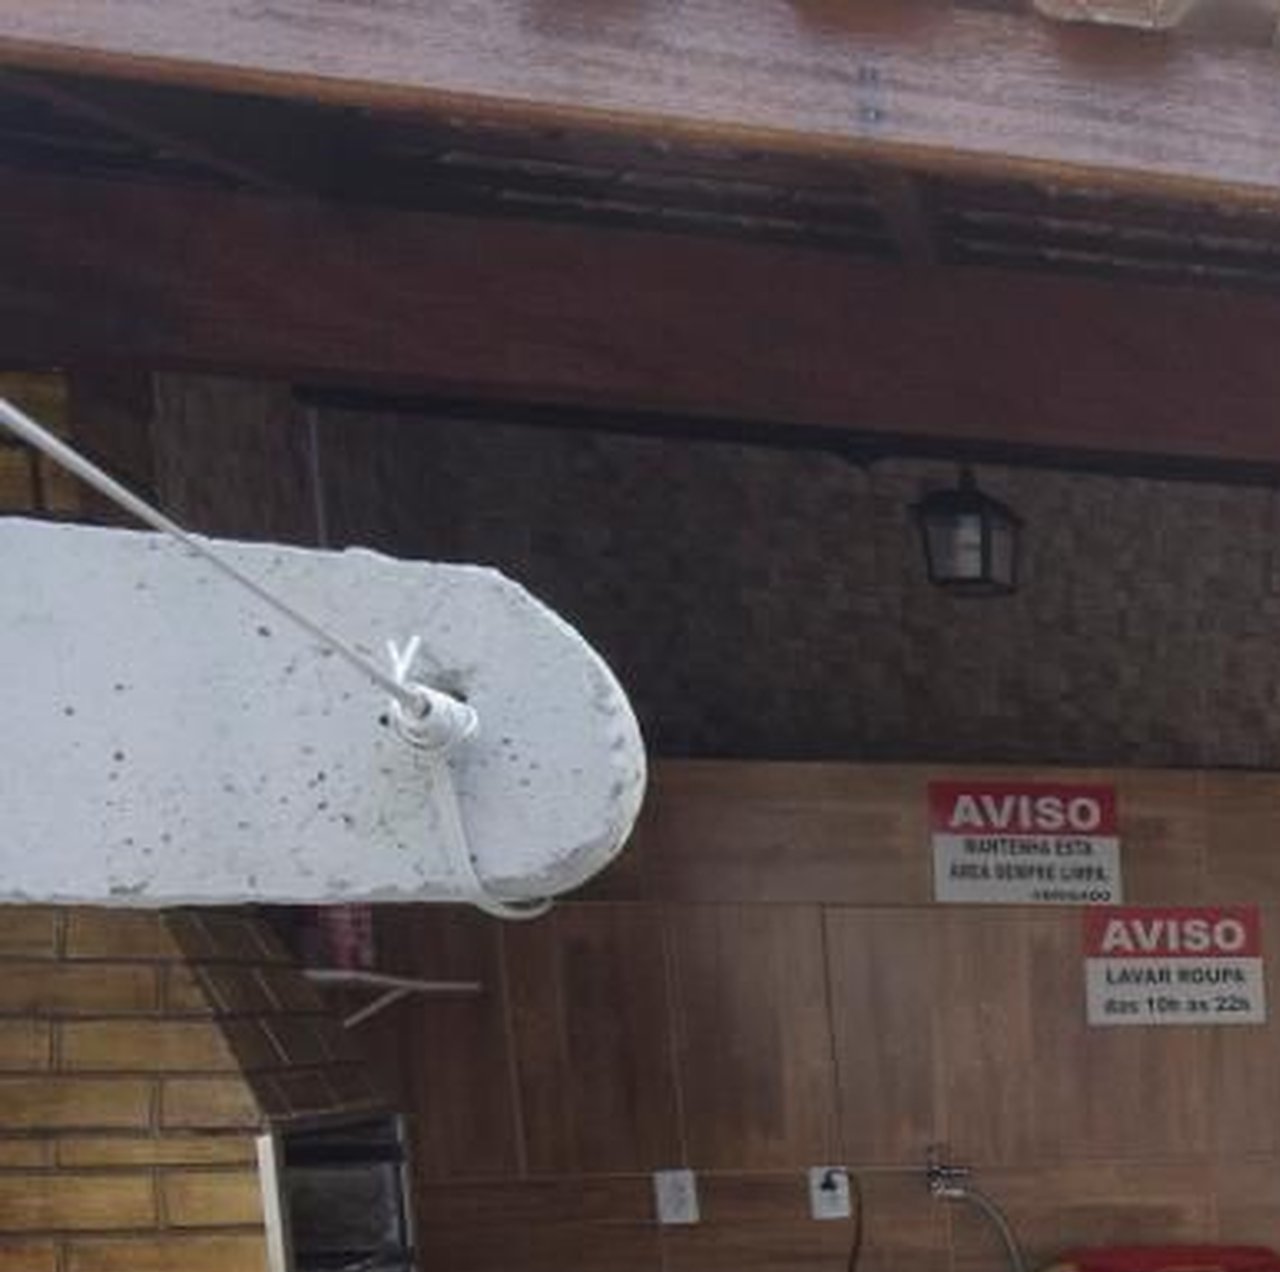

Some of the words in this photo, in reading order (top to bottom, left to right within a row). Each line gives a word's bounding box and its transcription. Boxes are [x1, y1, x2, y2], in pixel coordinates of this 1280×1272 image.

[950, 795, 1100, 829] AVISO
[1103, 919, 1246, 951] AVISO
[1106, 967, 1170, 985] LAVAR
[1178, 966, 1246, 984] ROUPA
